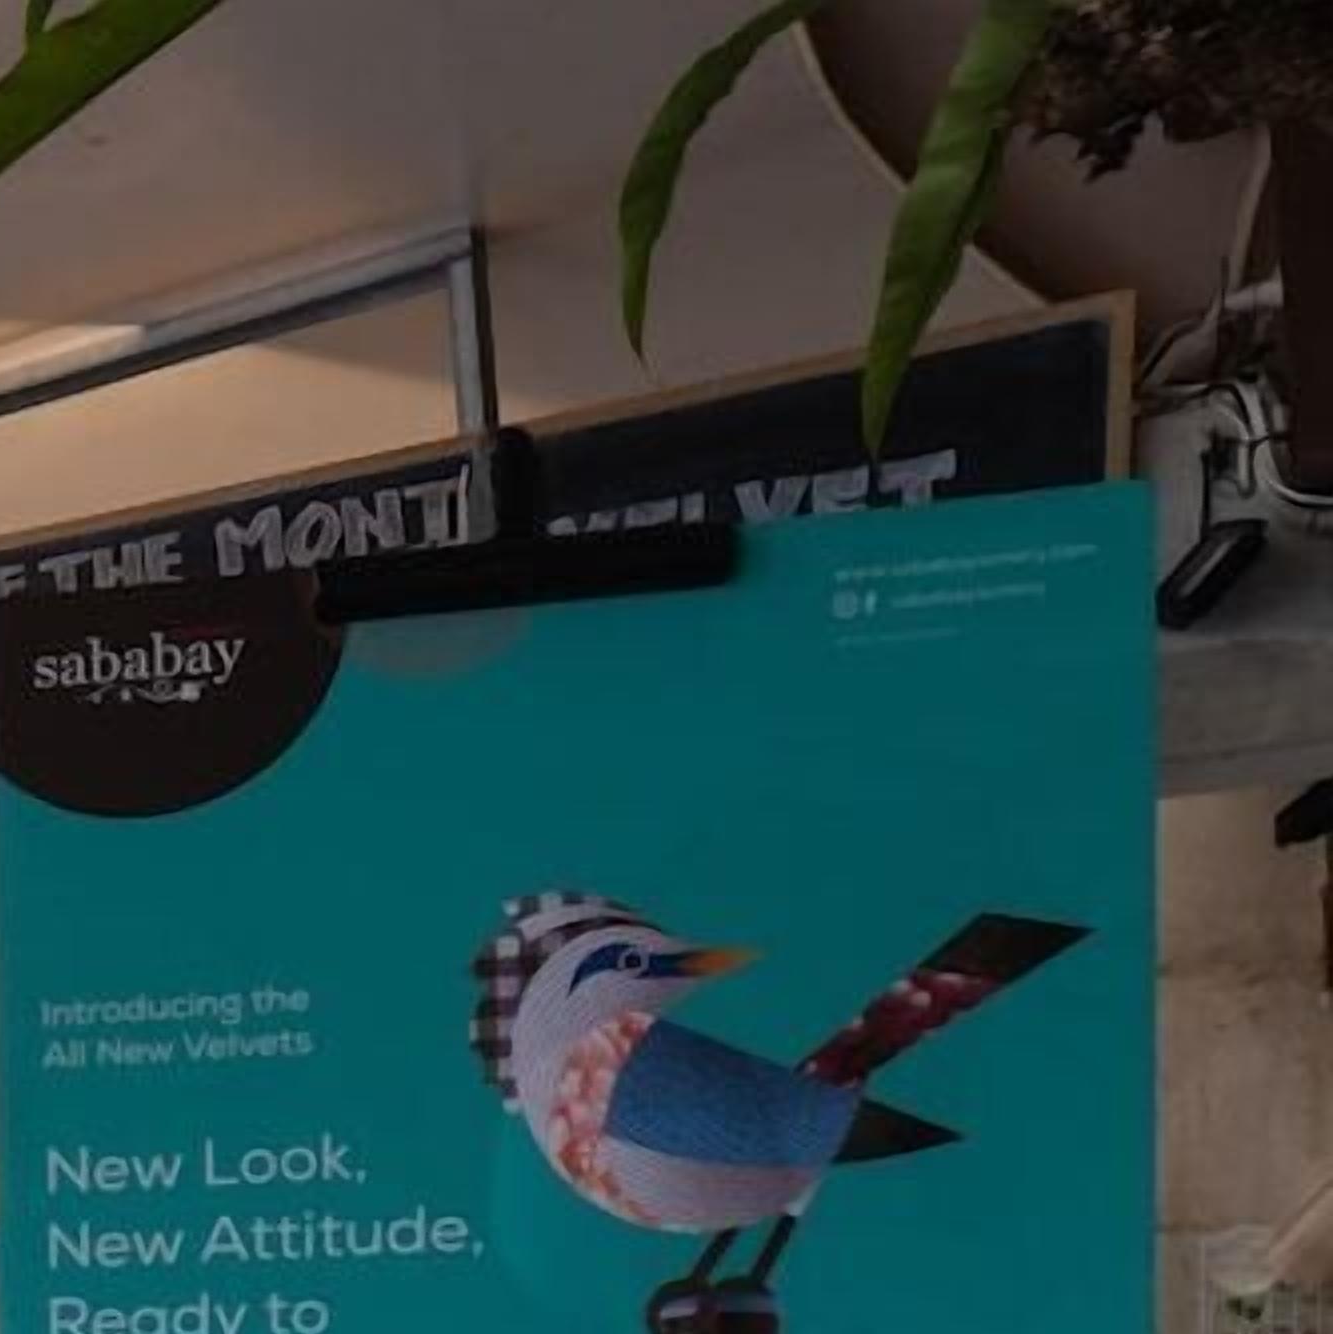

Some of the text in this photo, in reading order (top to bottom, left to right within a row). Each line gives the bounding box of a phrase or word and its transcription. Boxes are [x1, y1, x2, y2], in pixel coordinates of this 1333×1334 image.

[38, 531, 184, 592] THE
[214, 464, 469, 577] MONT
[33, 632, 245, 689] sababay
[40, 984, 310, 1025] Introducing the
[41, 1029, 313, 1068] All New Velvets
[47, 1132, 368, 1194] New Look,
[48, 1204, 484, 1270] New Attitude,
